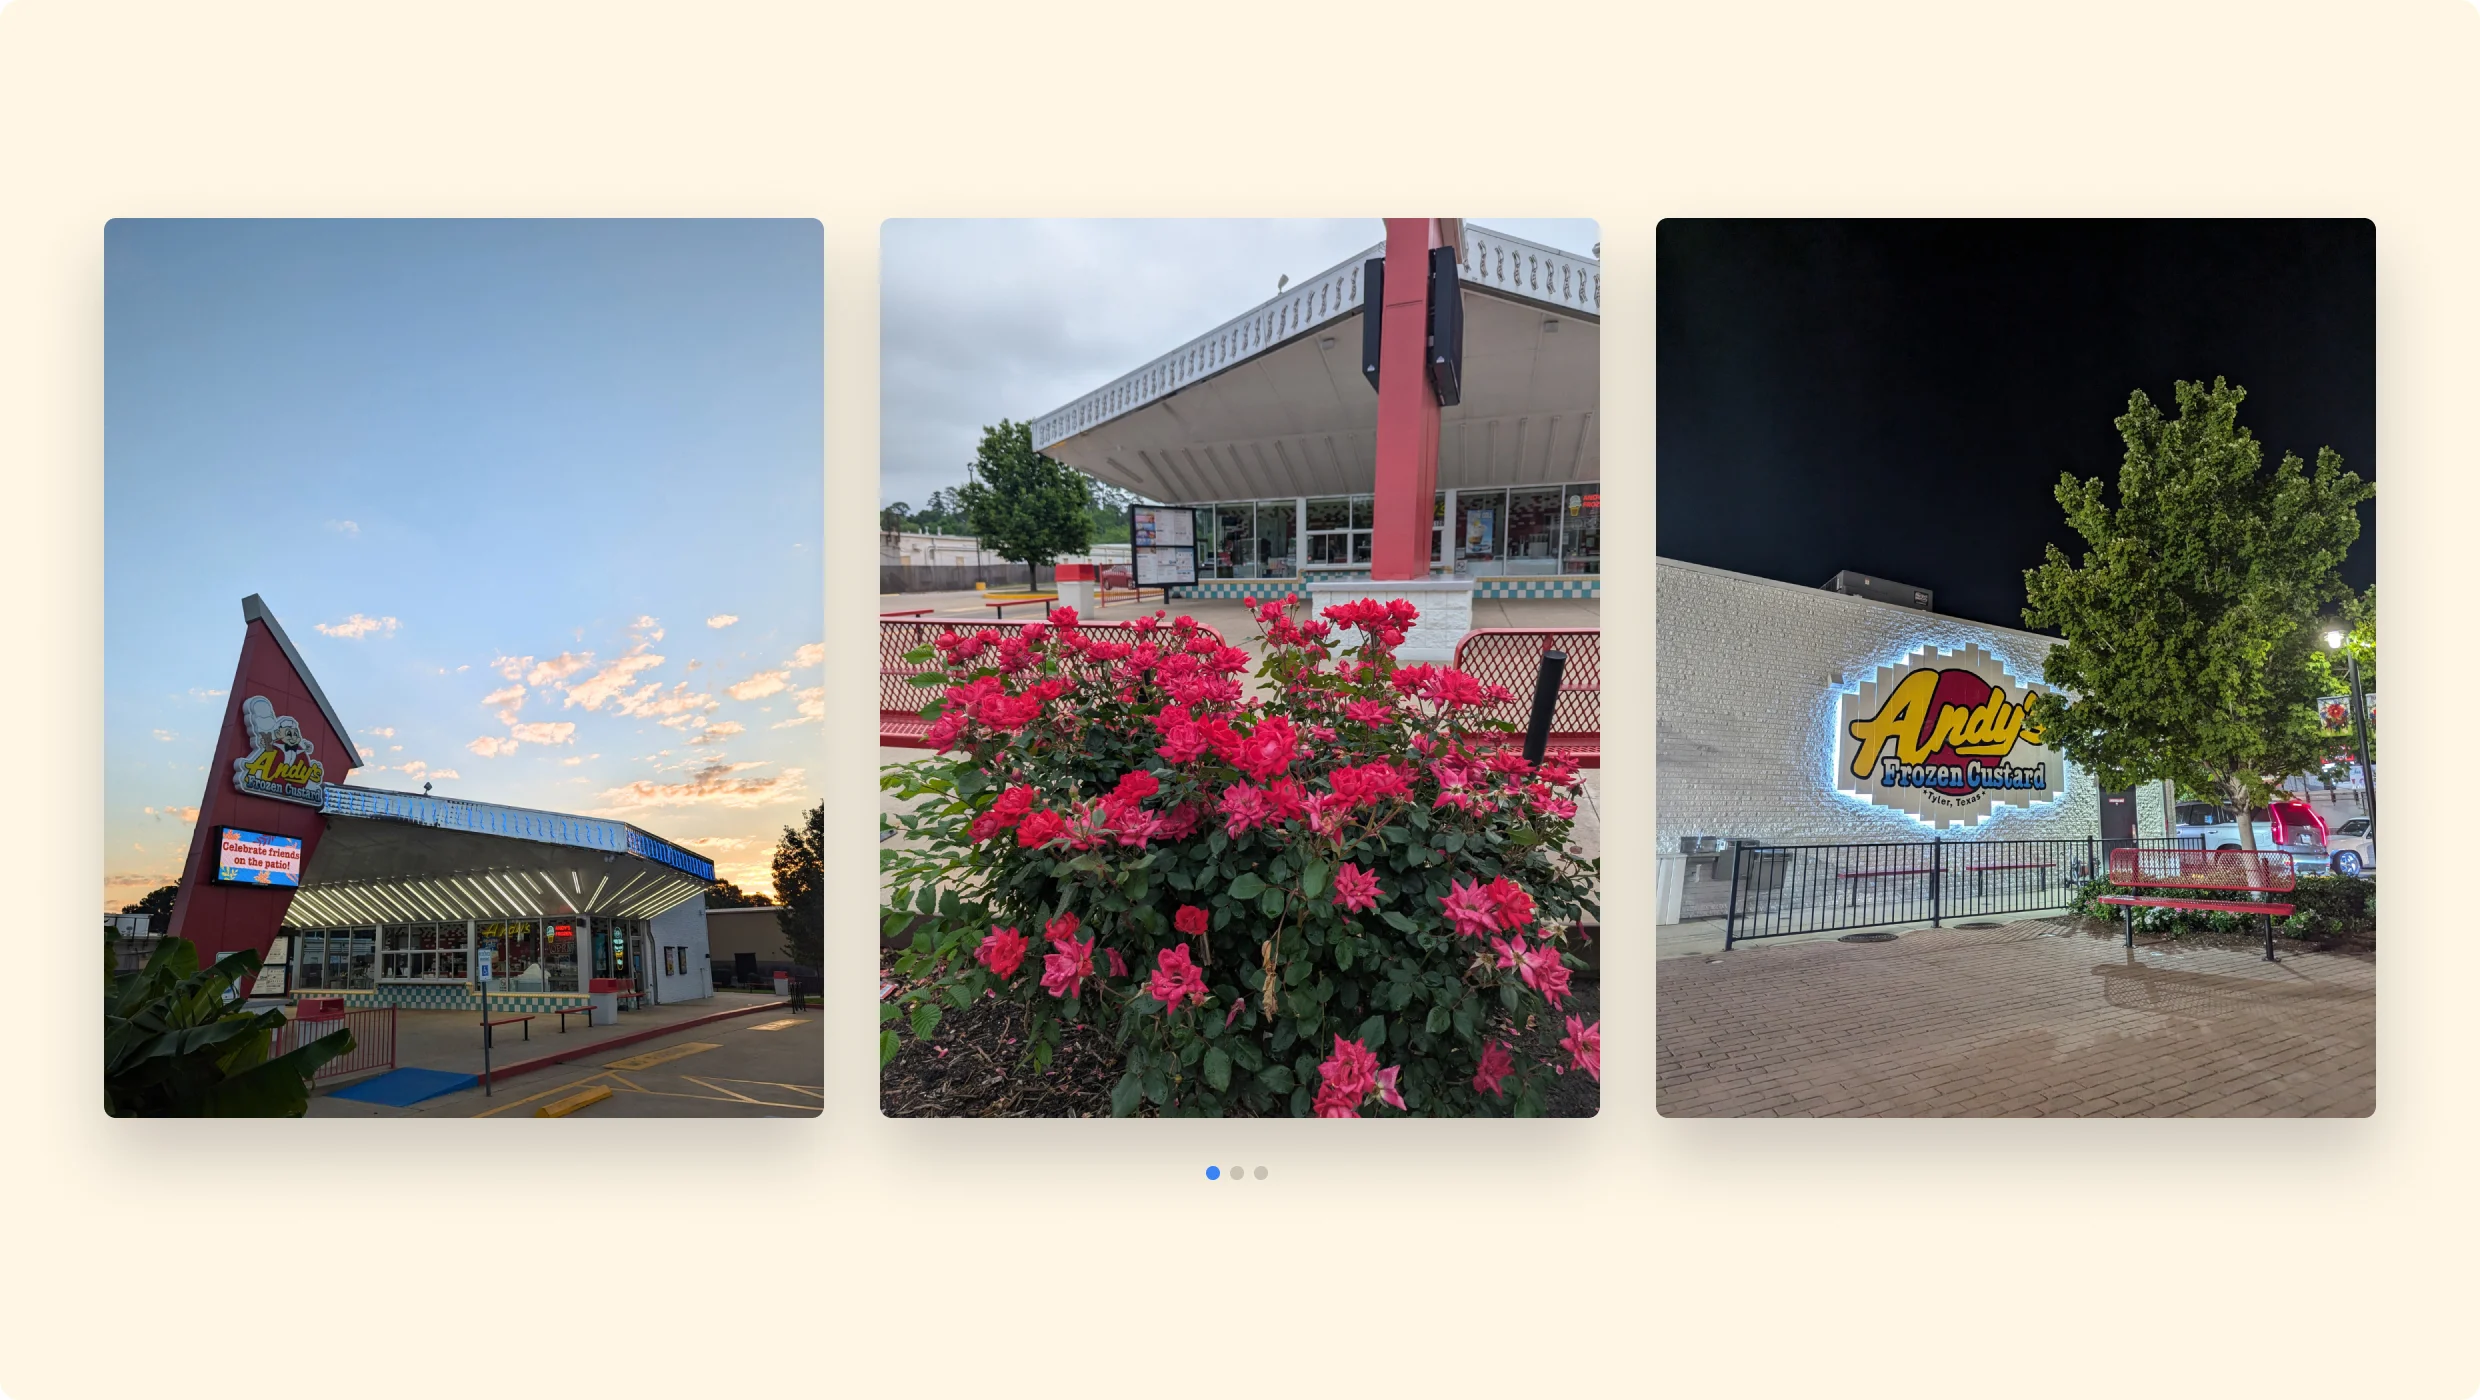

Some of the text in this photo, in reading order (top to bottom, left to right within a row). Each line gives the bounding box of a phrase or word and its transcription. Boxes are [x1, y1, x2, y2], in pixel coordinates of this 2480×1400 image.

[244, 749, 323, 784] Andy's
[1881, 756, 2047, 791] Frozen Custard
[246, 774, 322, 803] Frozen Custard
[1927, 793, 1982, 808] Tyler, Texas
[222, 841, 300, 860] Celebrate friends
[234, 857, 291, 871] on the patio!
